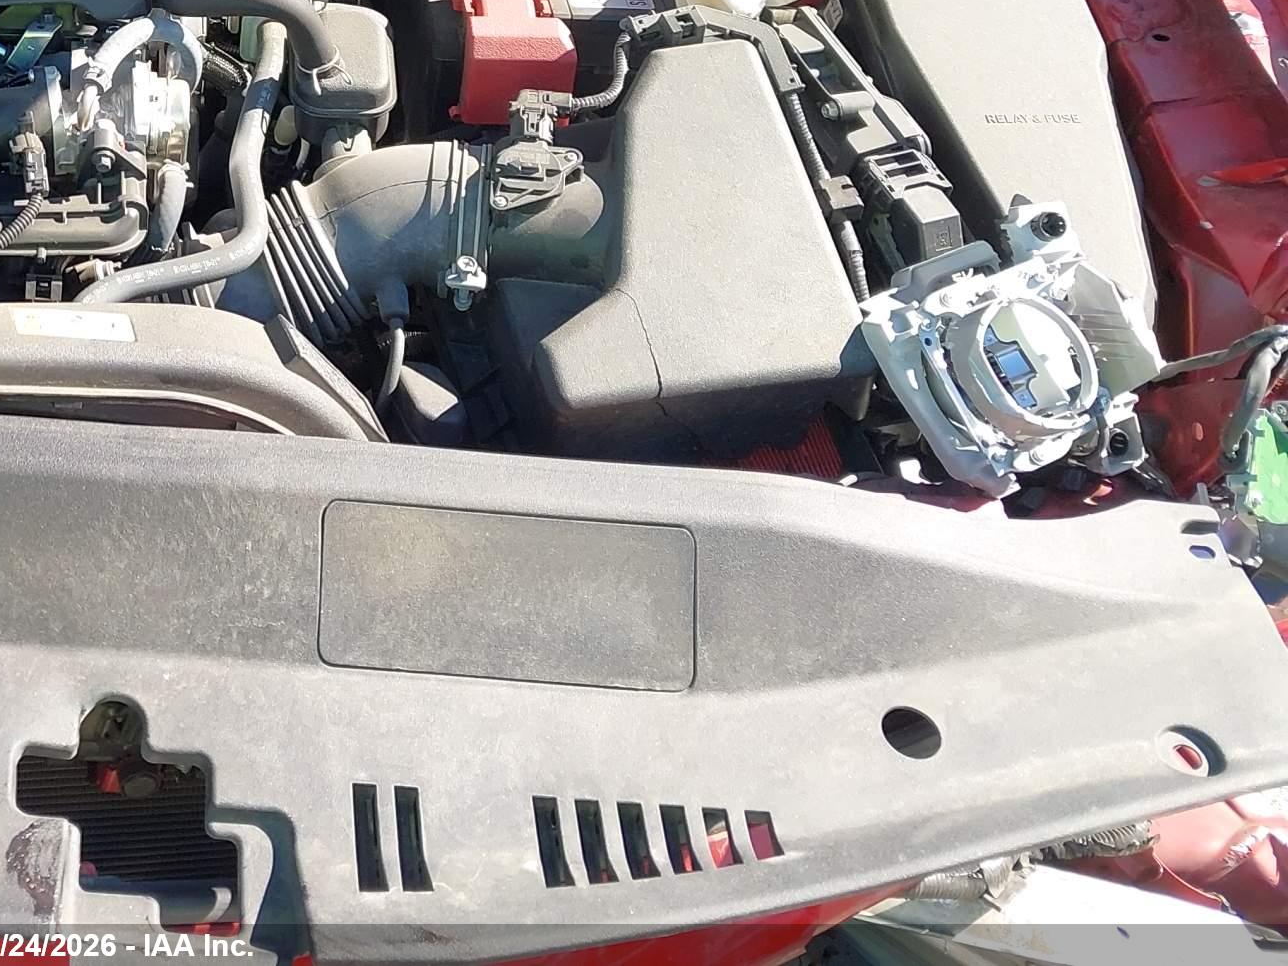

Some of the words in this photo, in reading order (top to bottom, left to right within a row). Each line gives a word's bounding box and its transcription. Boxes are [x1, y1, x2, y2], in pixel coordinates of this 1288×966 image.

[984, 113, 1028, 124] RELAY
[1031, 113, 1040, 124] &
[1045, 113, 1081, 124] FUSE
